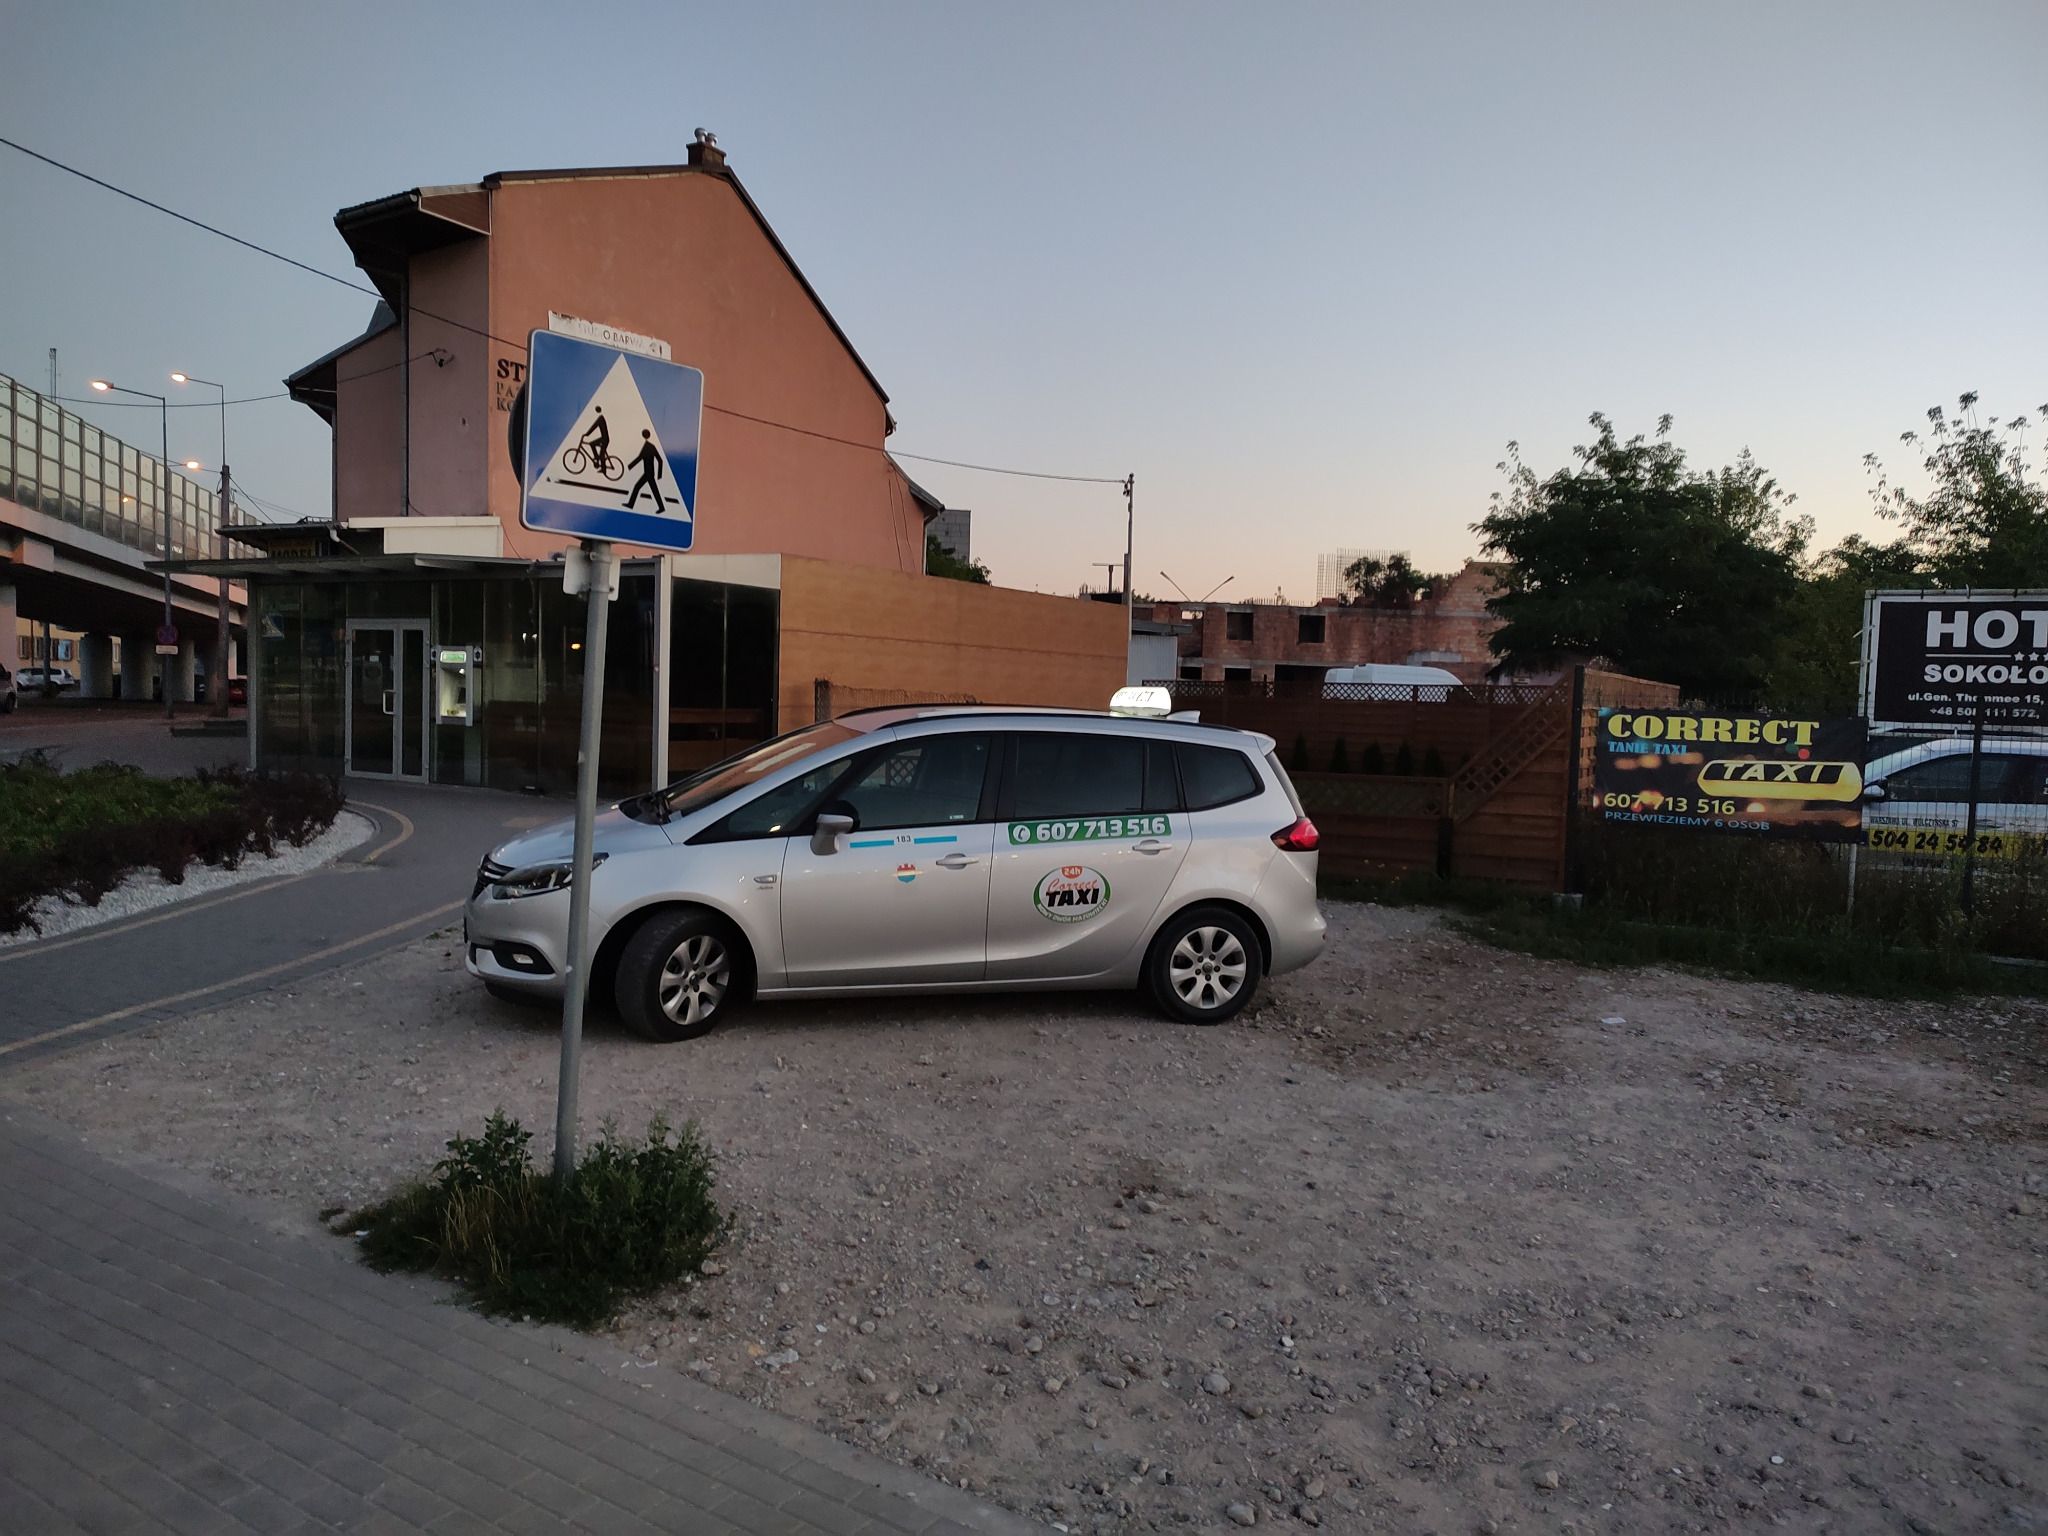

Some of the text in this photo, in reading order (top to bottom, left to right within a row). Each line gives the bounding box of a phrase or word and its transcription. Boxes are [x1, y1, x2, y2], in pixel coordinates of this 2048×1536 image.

[497, 358, 527, 382] ST
[1926, 610, 2048, 649] HOT
[1924, 664, 2048, 685] SOKOŁO
[2025, 695, 2045, 705] 15,
[1930, 707, 1953, 716] +48
[1608, 714, 1820, 746] CORRECT
[1608, 741, 1687, 755] TANIE TAXI
[1724, 763, 1825, 782] TAXI
[1604, 792, 1735, 815] 607 713 516
[1605, 810, 1710, 827] PRZEWIEZIEMY
[1714, 818, 1723, 828] 6
[896, 835, 911, 843] 183
[1036, 818, 1165, 841] 607 713 516
[1871, 830, 1909, 849] 504
[1915, 832, 1939, 851] 24
[1977, 835, 2003, 854] 84
[1064, 867, 1081, 876] 24h
[1047, 878, 1098, 892] Correct
[1046, 888, 1099, 907] TAXI
